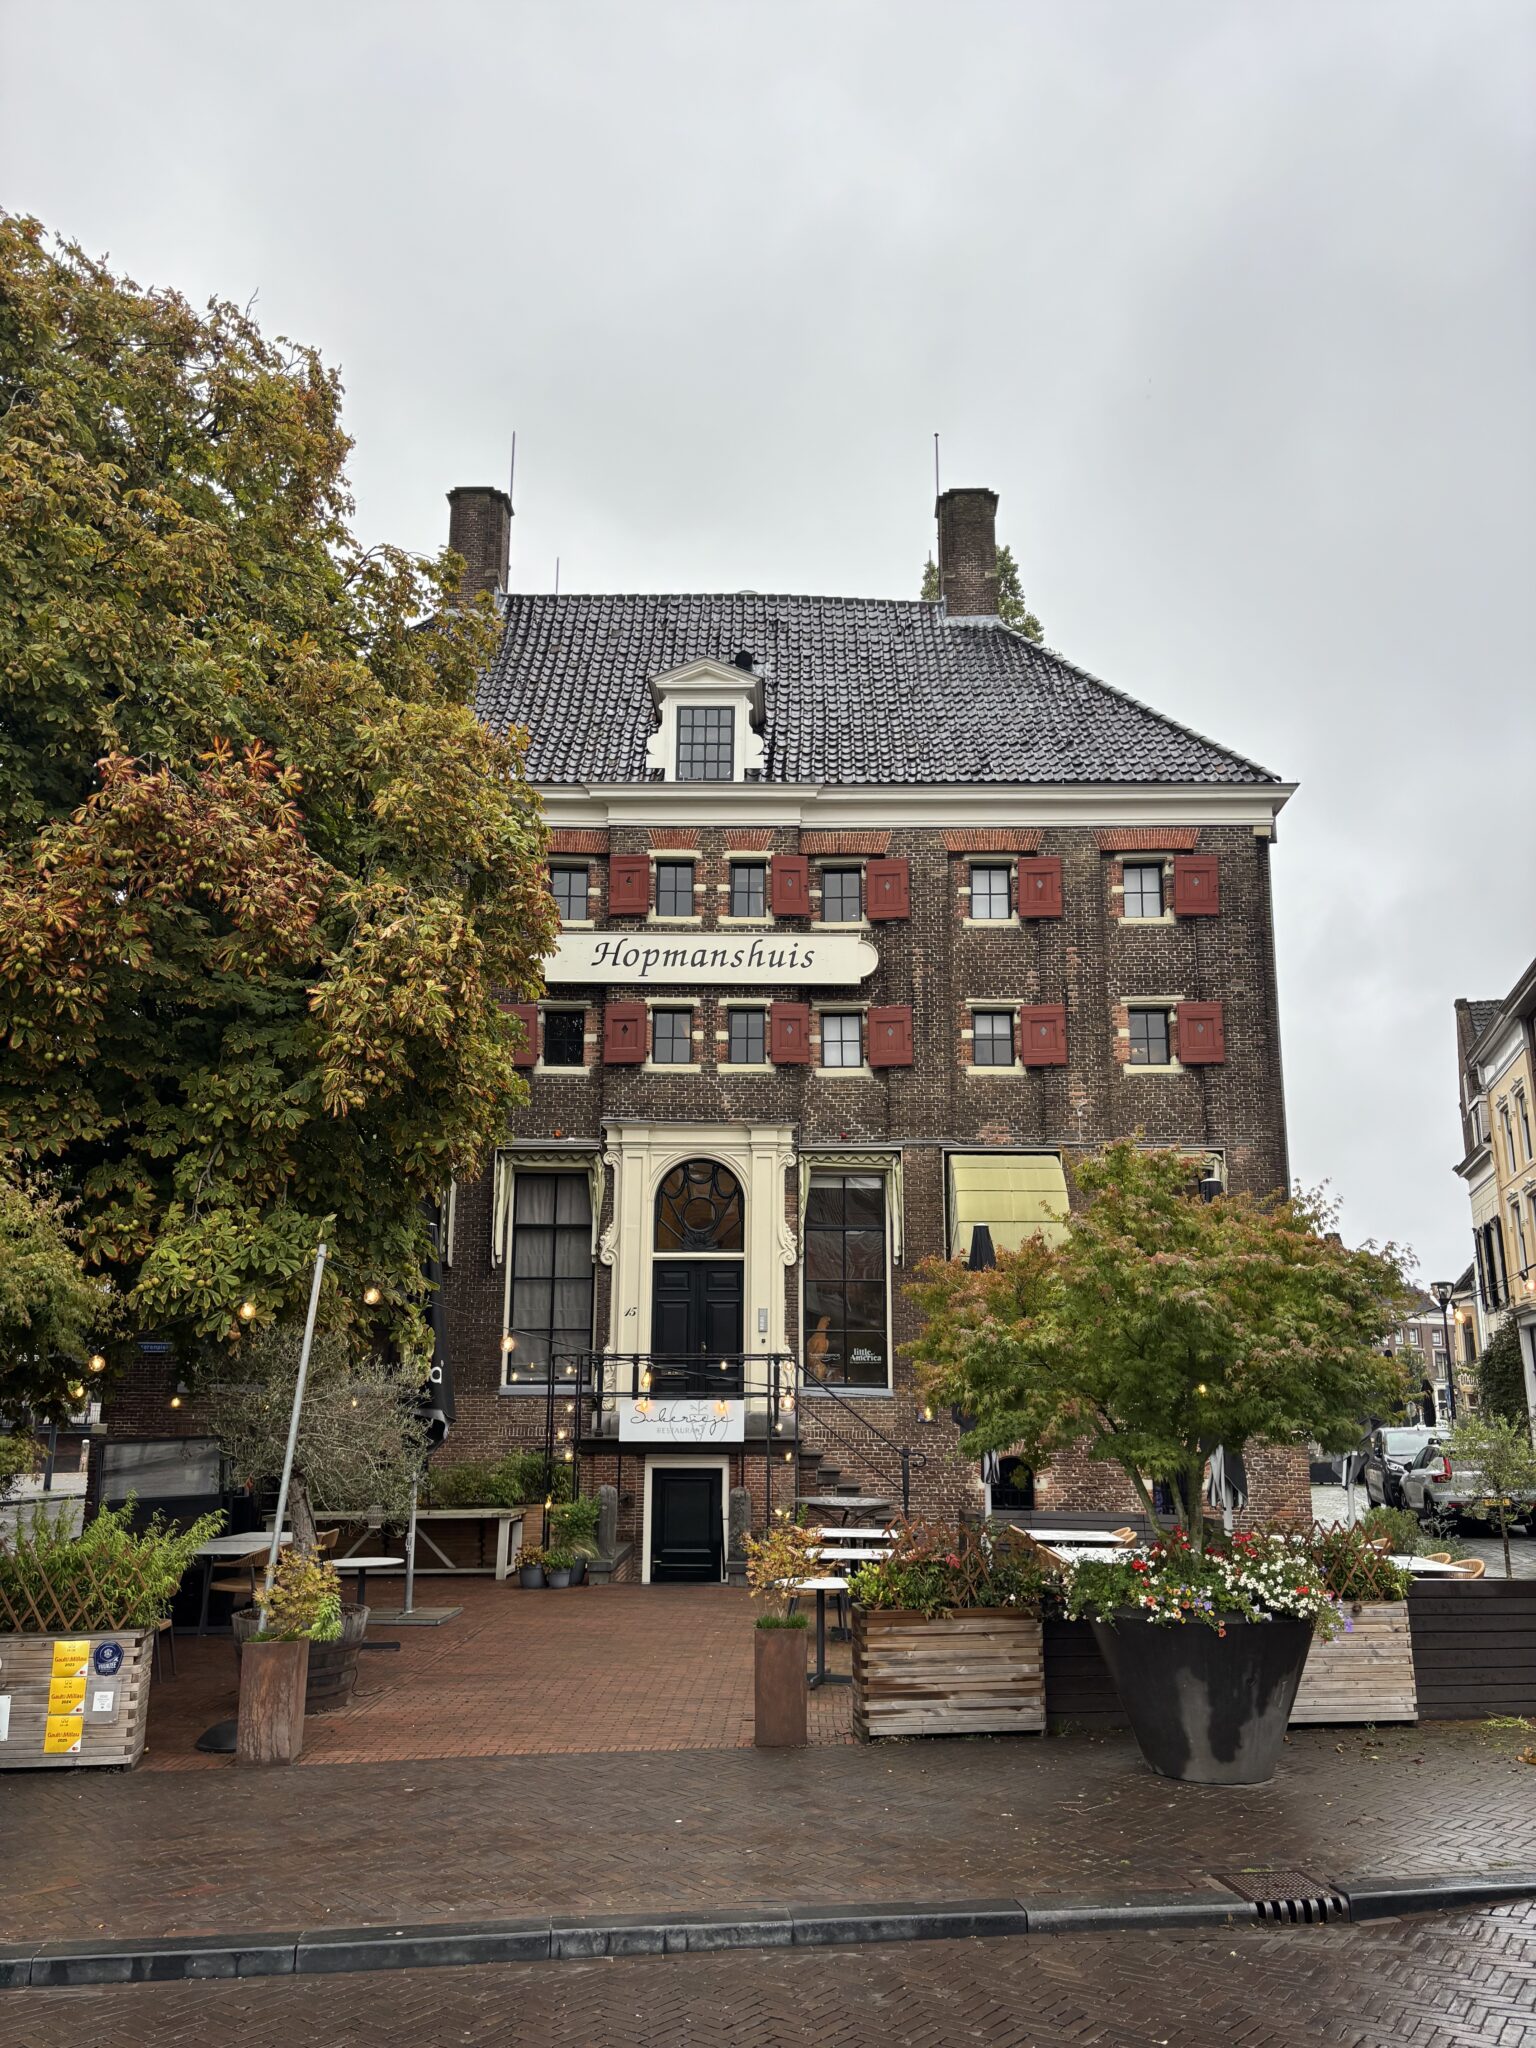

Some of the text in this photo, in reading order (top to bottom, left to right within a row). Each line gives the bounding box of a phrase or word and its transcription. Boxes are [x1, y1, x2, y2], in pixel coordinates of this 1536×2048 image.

[591, 938, 815, 977] Hopmanshuis
[624, 1307, 637, 1316] 15
[630, 1403, 734, 1436] Sukerieje
[656, 1426, 705, 1434] RESTAURANT
